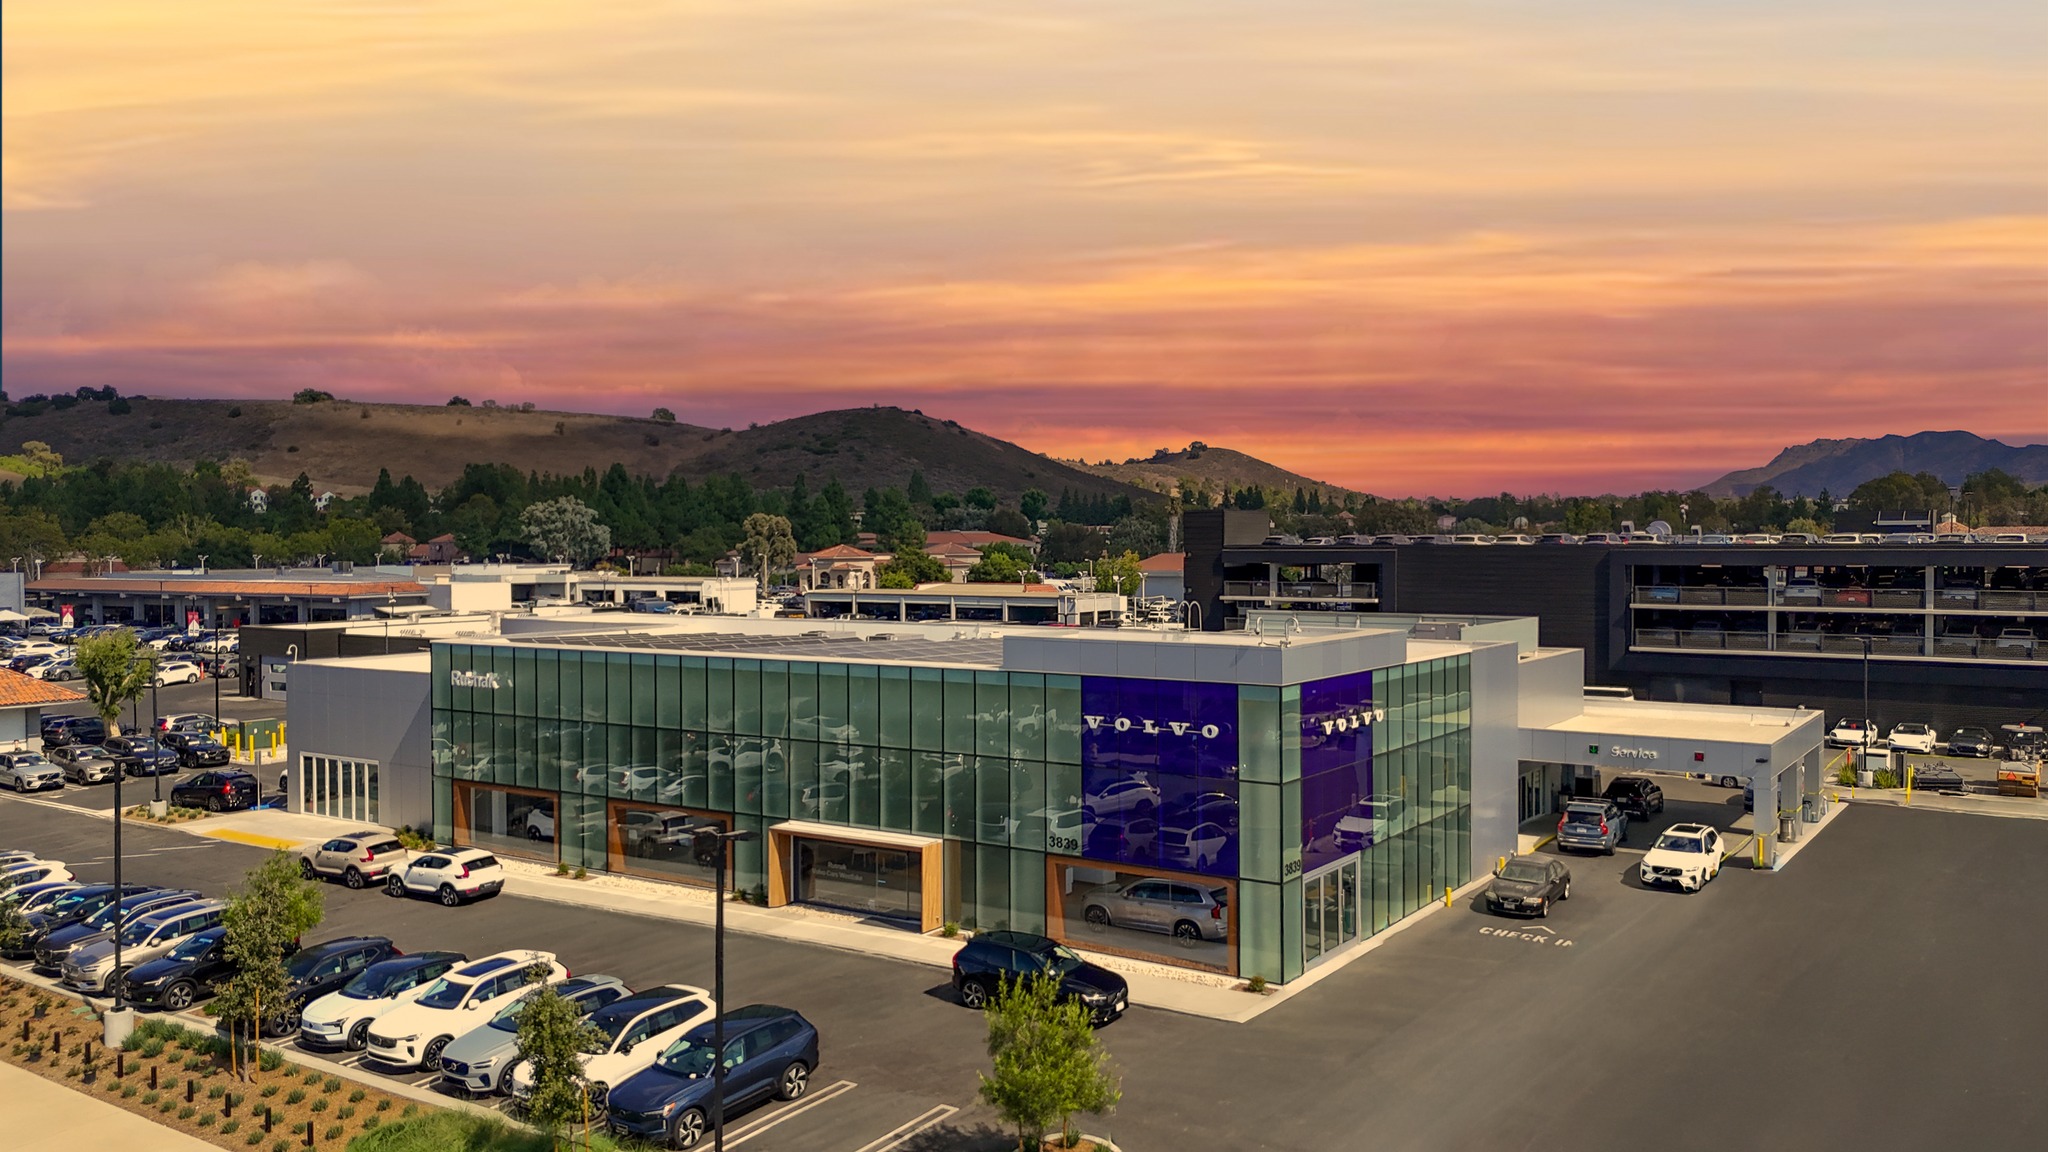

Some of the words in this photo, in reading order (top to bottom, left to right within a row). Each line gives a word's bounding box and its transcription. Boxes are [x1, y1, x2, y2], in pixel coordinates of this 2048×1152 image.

[1083, 715, 1219, 739] VOLVO
[1320, 709, 1384, 735] VOLVO
[1611, 745, 1657, 760] Service
[1048, 836, 1078, 850] 3839
[1285, 859, 1301, 876] 3839
[1479, 926, 1549, 944] CHECK
